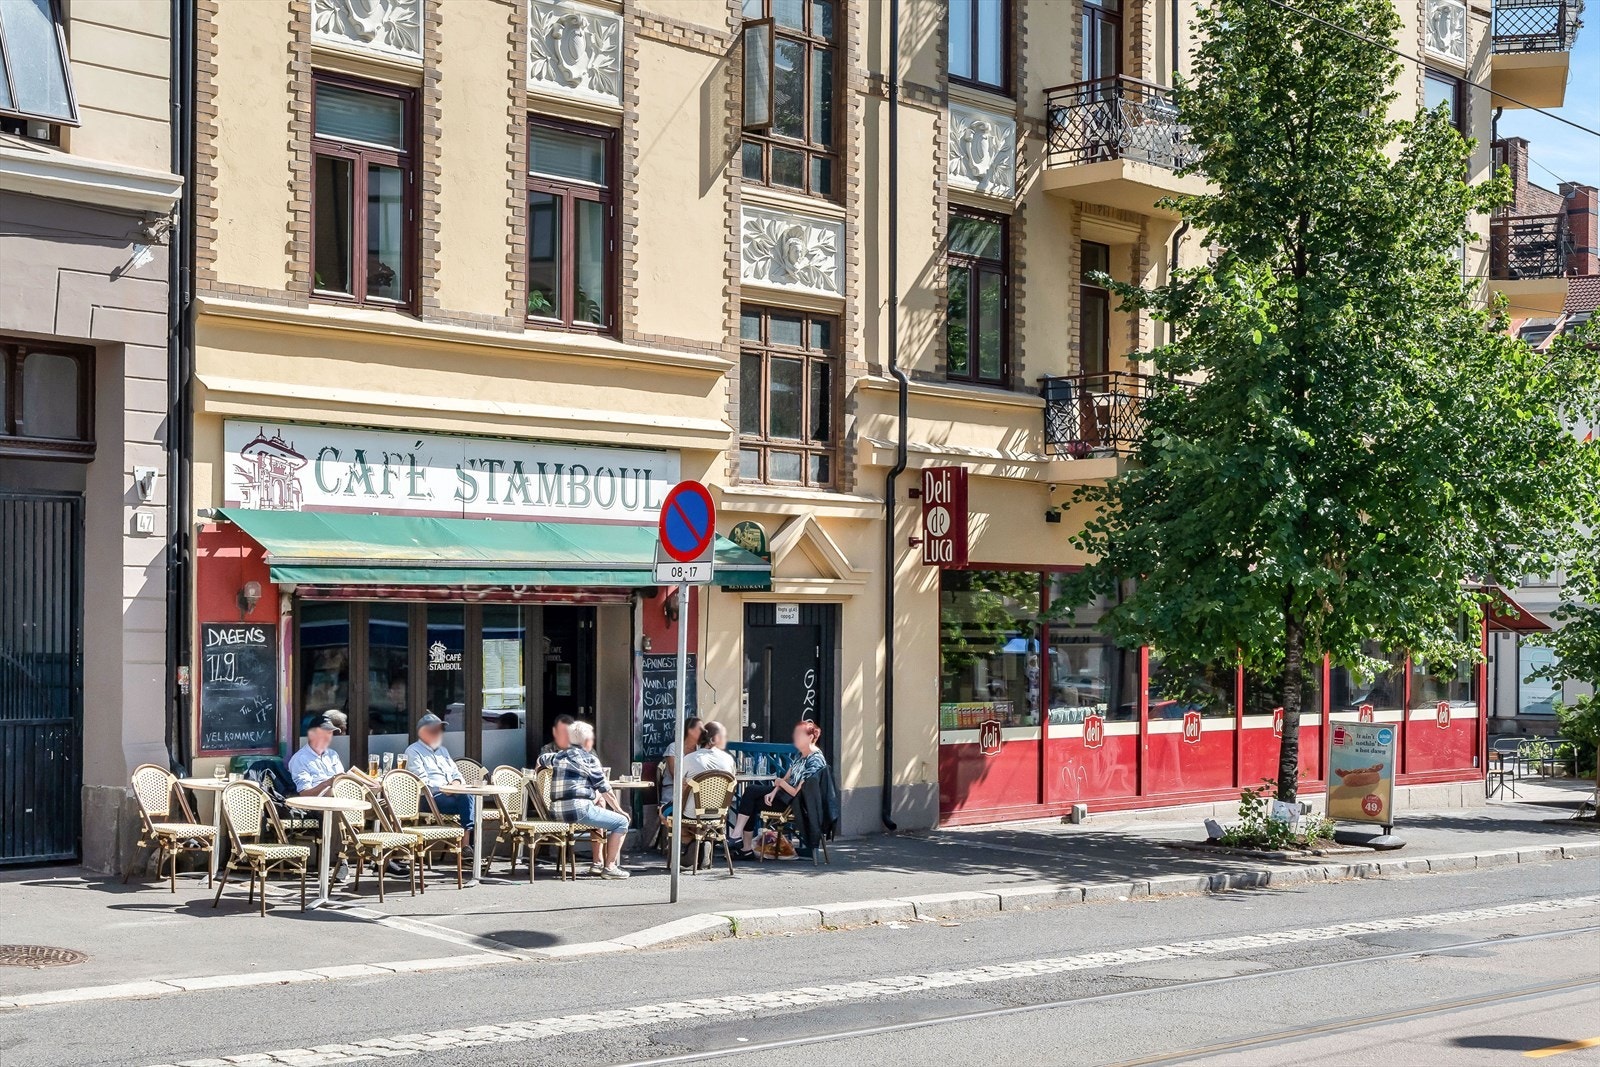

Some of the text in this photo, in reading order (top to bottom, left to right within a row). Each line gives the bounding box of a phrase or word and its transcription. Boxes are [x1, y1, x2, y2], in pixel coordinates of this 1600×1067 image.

[314, 440, 663, 512] CAFÉ STAMBOUL
[925, 470, 951, 504] Deli
[140, 515, 152, 530] 47
[931, 507, 945, 535] de
[924, 529, 953, 562] Luca
[205, 627, 266, 647] DAGENS
[429, 662, 462, 671] STAMBOUL
[445, 652, 462, 662] CAFÉ
[1186, 716, 1198, 731] deli
[1438, 706, 1448, 724] deli
[983, 727, 998, 748] deli
[1086, 722, 1100, 742] deli
